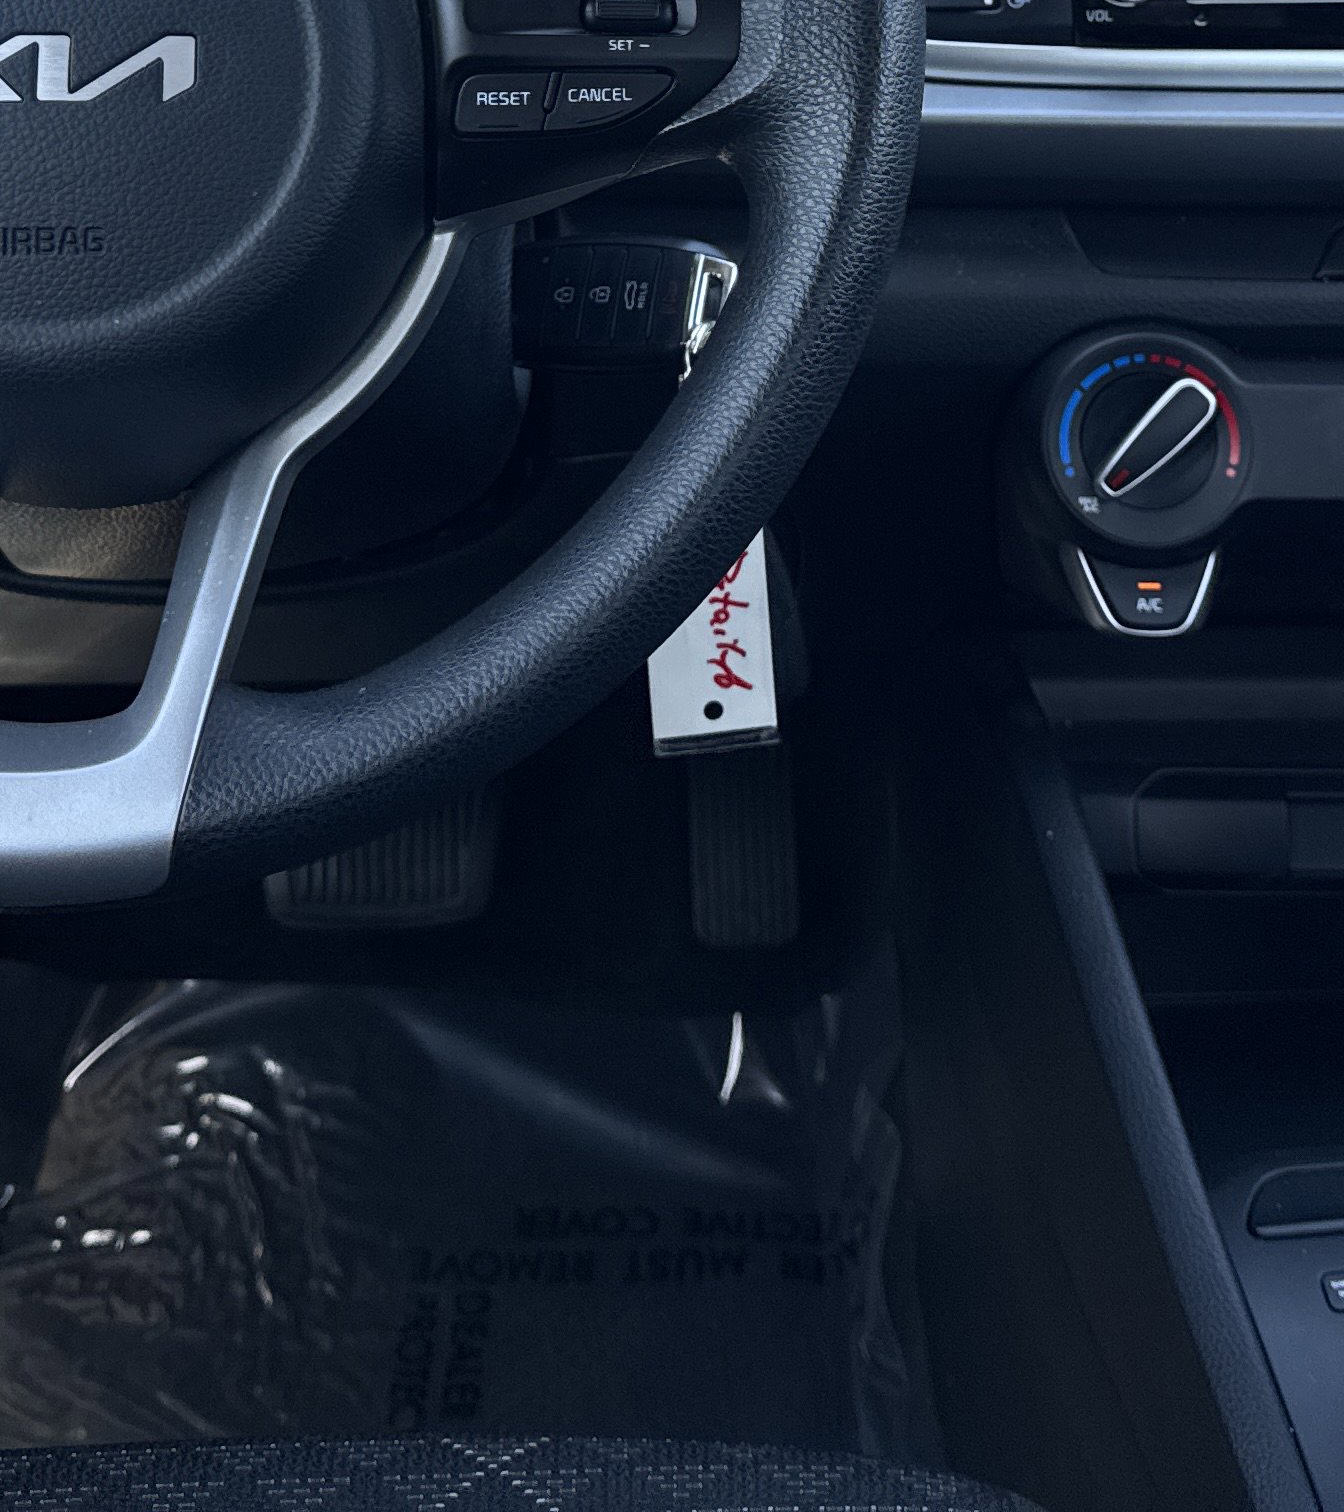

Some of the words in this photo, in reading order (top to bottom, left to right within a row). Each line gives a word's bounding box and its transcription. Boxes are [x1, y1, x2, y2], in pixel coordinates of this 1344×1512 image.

[1086, 9, 1113, 23] VOL
[608, 39, 633, 51] SET
[476, 91, 531, 106] RESET
[567, 88, 633, 102] CANCEL
[1136, 598, 1163, 613] A/C
[515, 1206, 661, 1241] COVER
[623, 1245, 749, 1285] MUST
